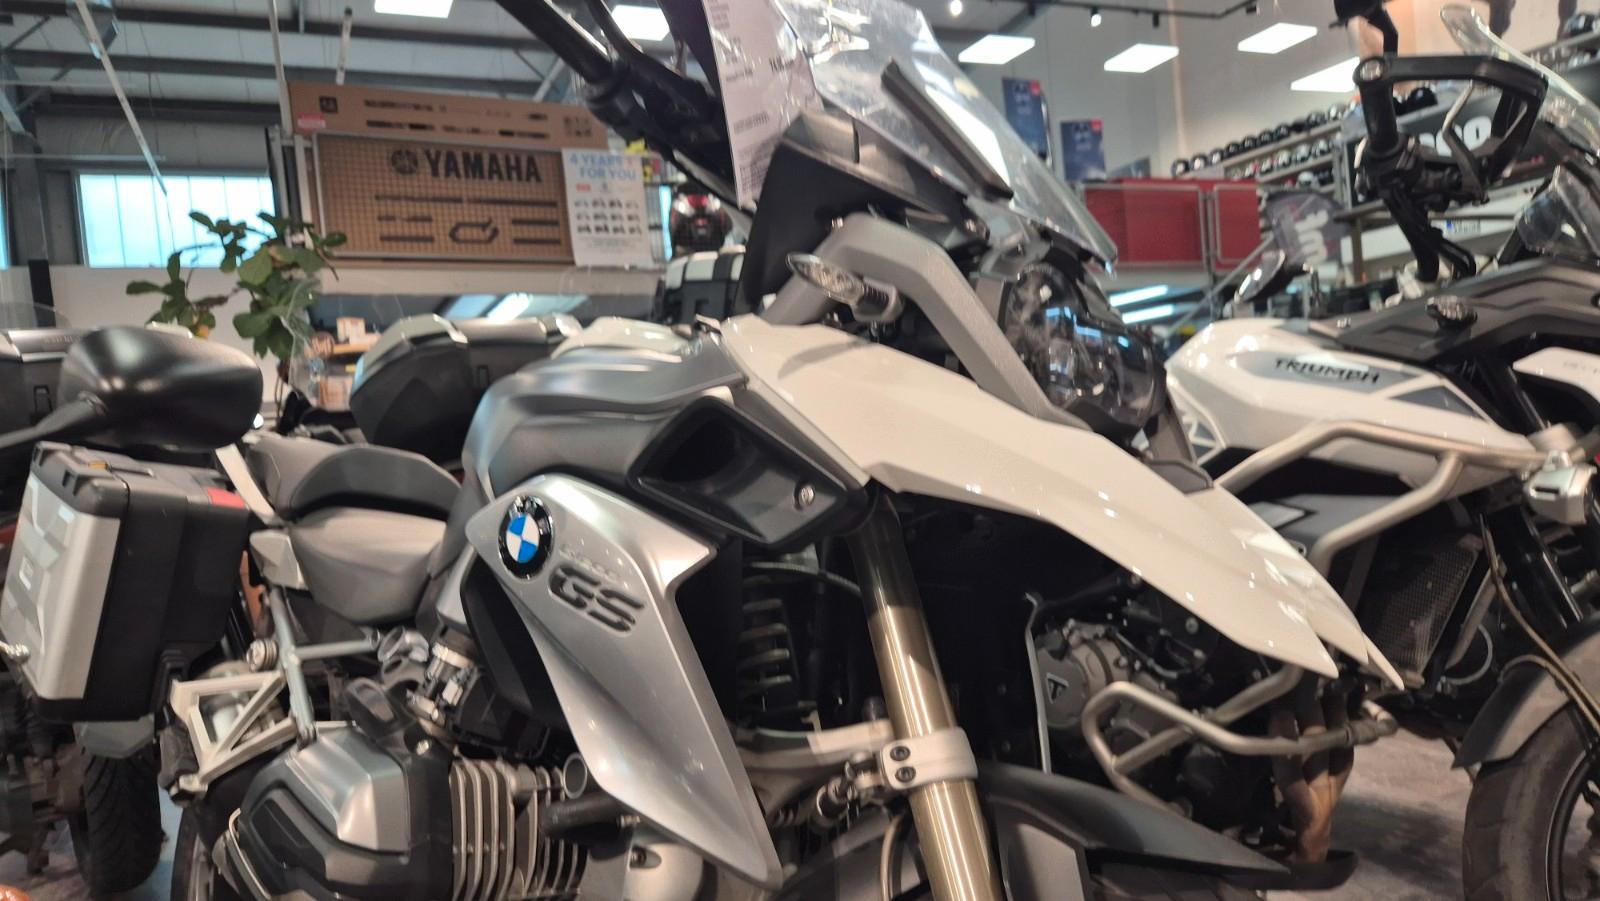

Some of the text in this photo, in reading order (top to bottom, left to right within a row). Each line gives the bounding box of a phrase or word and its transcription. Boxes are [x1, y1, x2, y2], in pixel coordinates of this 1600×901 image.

[424, 150, 542, 182] YAMAHA
[609, 168, 636, 180] YOU
[1274, 358, 1380, 383] TRIUMPH
[549, 566, 645, 632] GS
